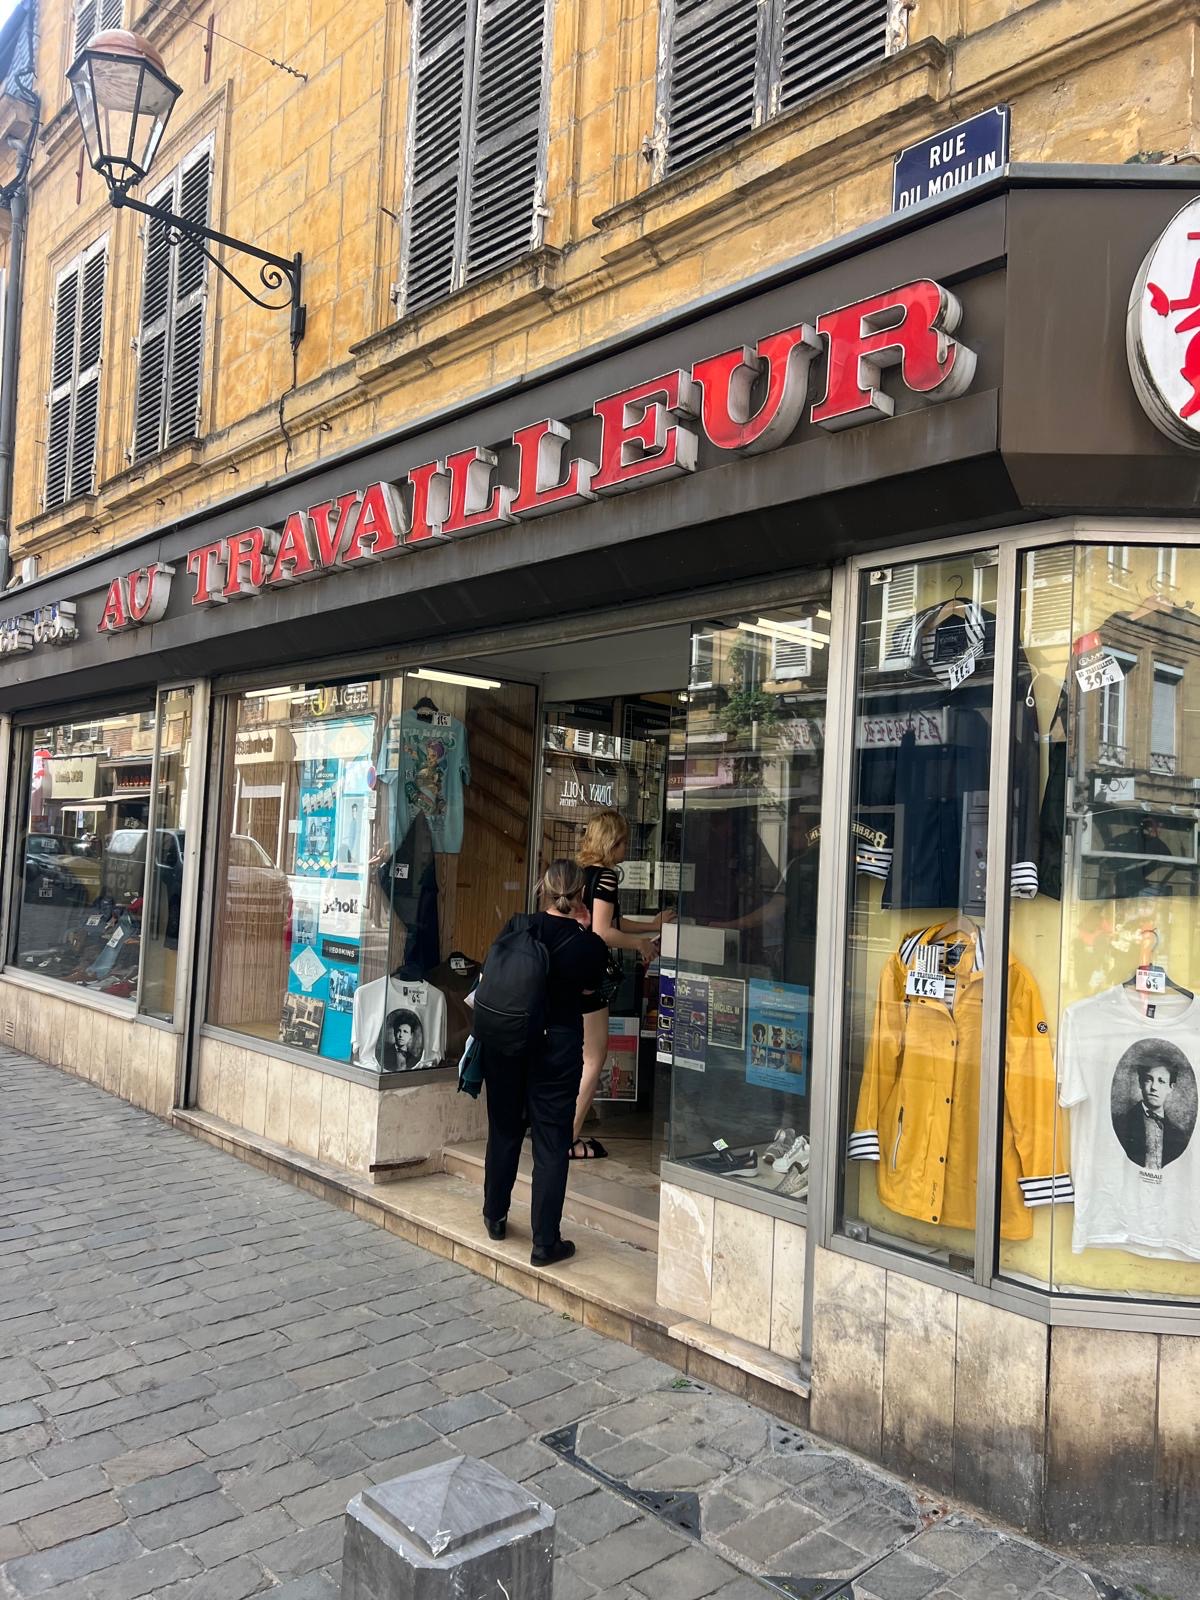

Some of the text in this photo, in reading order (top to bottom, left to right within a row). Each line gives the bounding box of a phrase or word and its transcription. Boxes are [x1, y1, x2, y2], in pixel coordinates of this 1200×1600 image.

[929, 132, 966, 169] RUE
[899, 151, 996, 211] DU MOULIN
[97, 277, 976, 633] AU TRAVAILLEUR
[330, 686, 368, 706] AIGLE
